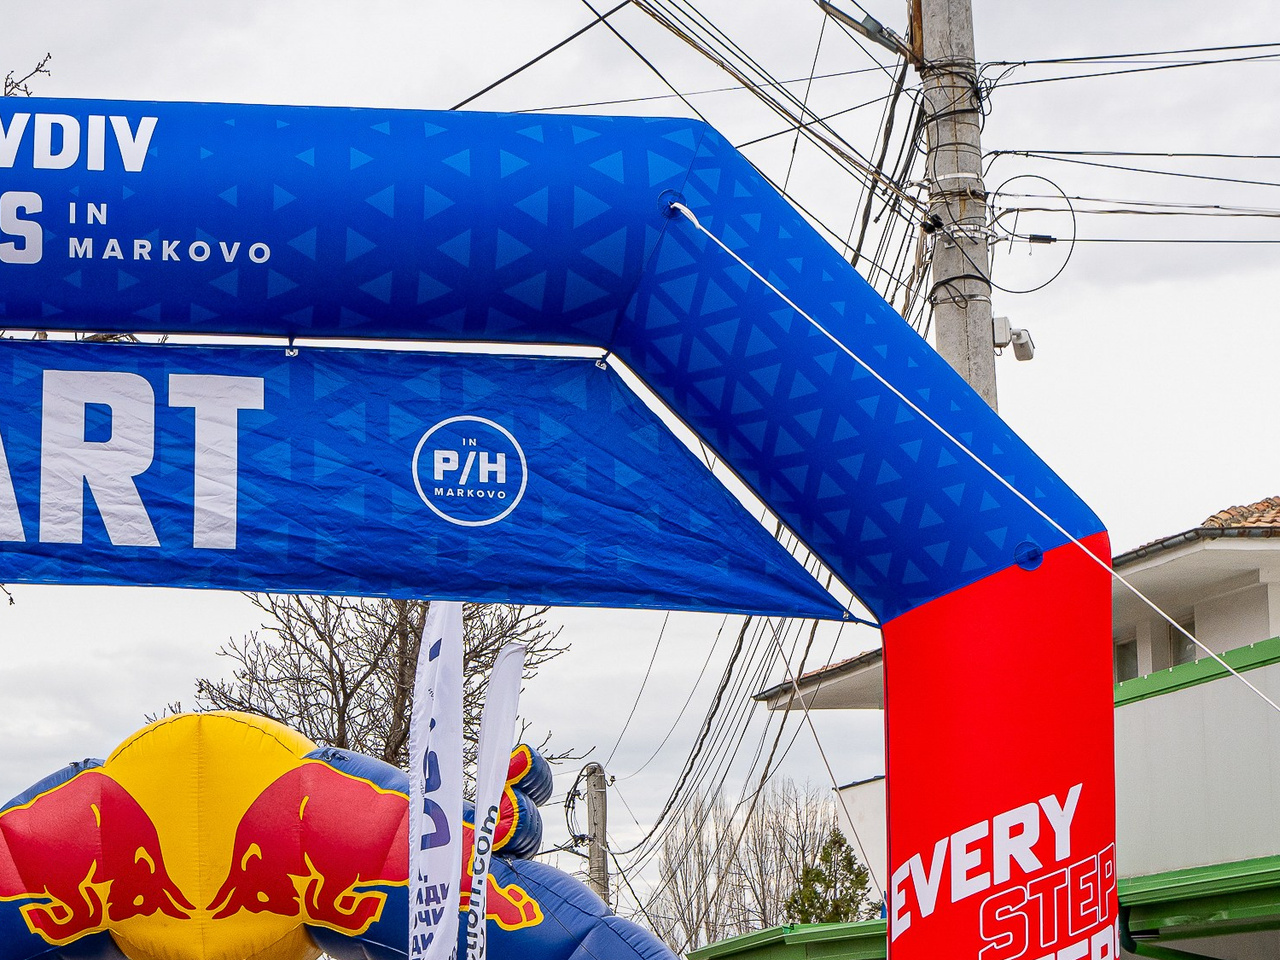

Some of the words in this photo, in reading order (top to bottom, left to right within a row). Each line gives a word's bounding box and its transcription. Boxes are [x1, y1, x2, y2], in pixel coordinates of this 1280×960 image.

[69, 202, 108, 225] IN
[68, 237, 272, 263] MARKOVO
[462, 438, 477, 446] IN
[433, 449, 506, 485] P/H
[434, 487, 506, 499] MARKOVO
[891, 783, 1083, 943] EVERY
